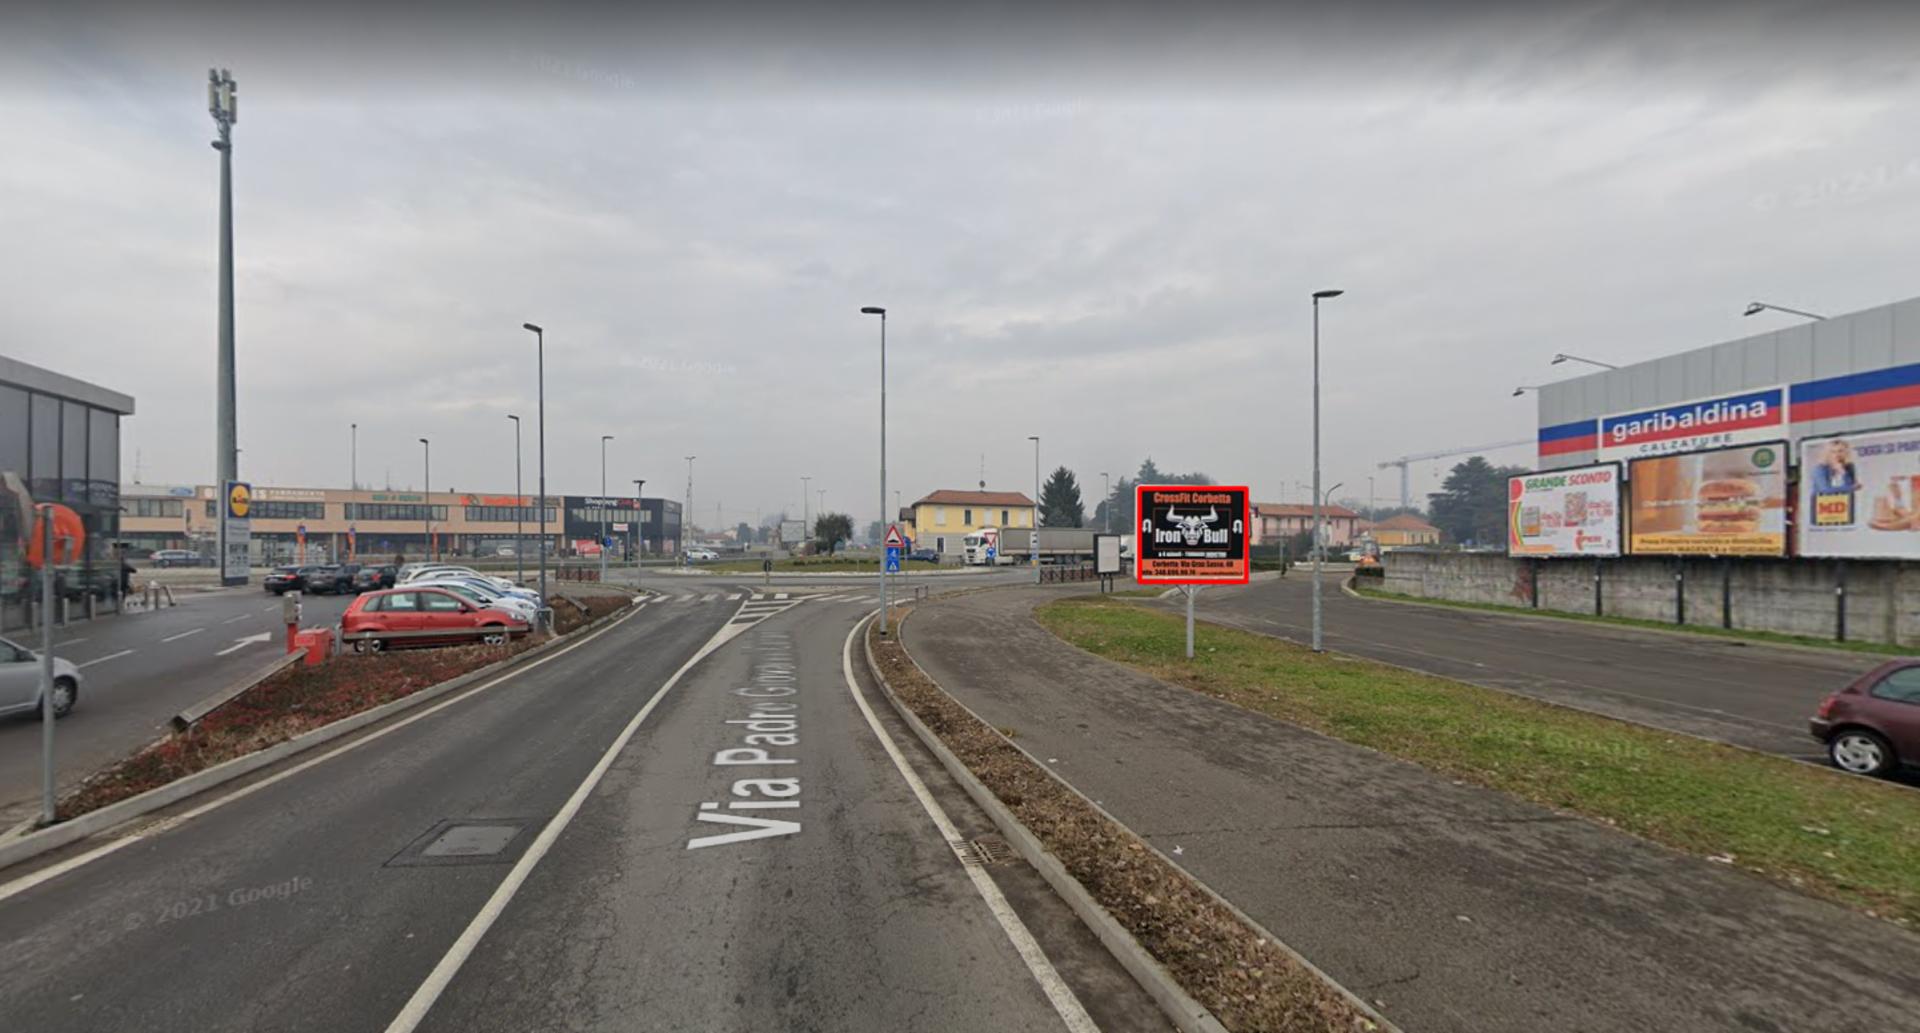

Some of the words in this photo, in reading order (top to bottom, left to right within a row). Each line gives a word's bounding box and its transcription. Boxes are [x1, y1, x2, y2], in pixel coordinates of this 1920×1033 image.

[1611, 399, 1768, 442] garibaldina
[1639, 433, 1735, 453] CALZATURE
[1525, 475, 1567, 489] GRANDE
[1567, 470, 1612, 486] SCONTO
[1153, 492, 1191, 504] CrossFit
[1192, 492, 1232, 504] Corbetta
[1155, 528, 1181, 543] Iron
[1203, 528, 1228, 543] Bull
[686, 776, 801, 850] Via
